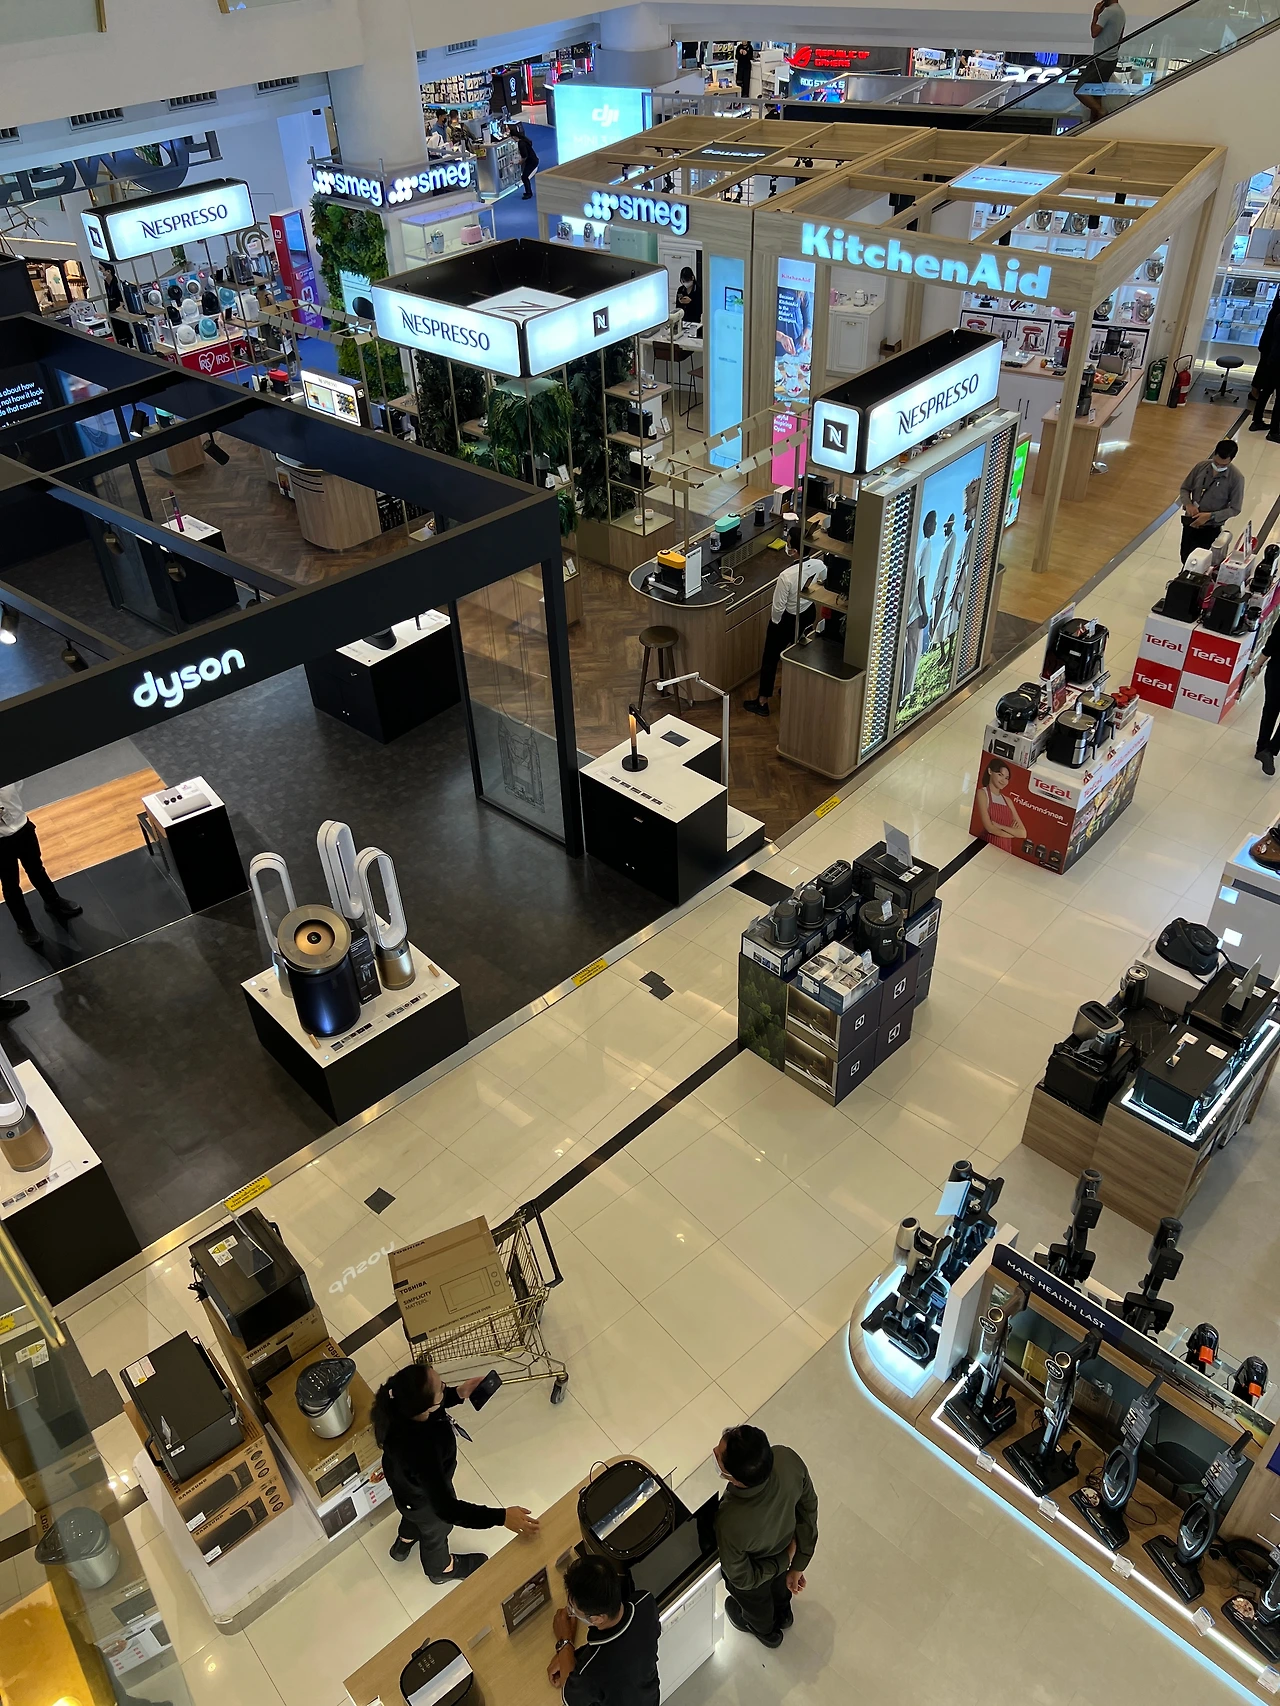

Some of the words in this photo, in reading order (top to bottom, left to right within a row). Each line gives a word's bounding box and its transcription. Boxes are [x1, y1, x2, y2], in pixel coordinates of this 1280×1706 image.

[334, 174, 383, 207] smeg
[417, 161, 471, 194] smeg
[136, 204, 228, 240] NESPRESSO
[619, 194, 689, 236] smeg
[801, 222, 1052, 299] KitchenAid
[397, 306, 490, 351] NESPRESSO
[896, 373, 979, 436] NESPRESSO
[1145, 633, 1183, 654] Tefal
[1191, 646, 1232, 668] Tefal
[133, 648, 246, 709] dyson
[1136, 672, 1174, 693] Tefal
[1180, 687, 1220, 708] Tefal
[1033, 777, 1072, 800] Tefal
[400, 1280, 428, 1295] TOSHIBA
[403, 1290, 432, 1306] SIMPLICITY
[1006, 1260, 1035, 1283] MAKE
[1038, 1280, 1078, 1311] HEALTH
[1079, 1309, 1106, 1329] LAST
[245, 1342, 271, 1360] TOSHIBA
[178, 1478, 207, 1500] SAMSUNG
